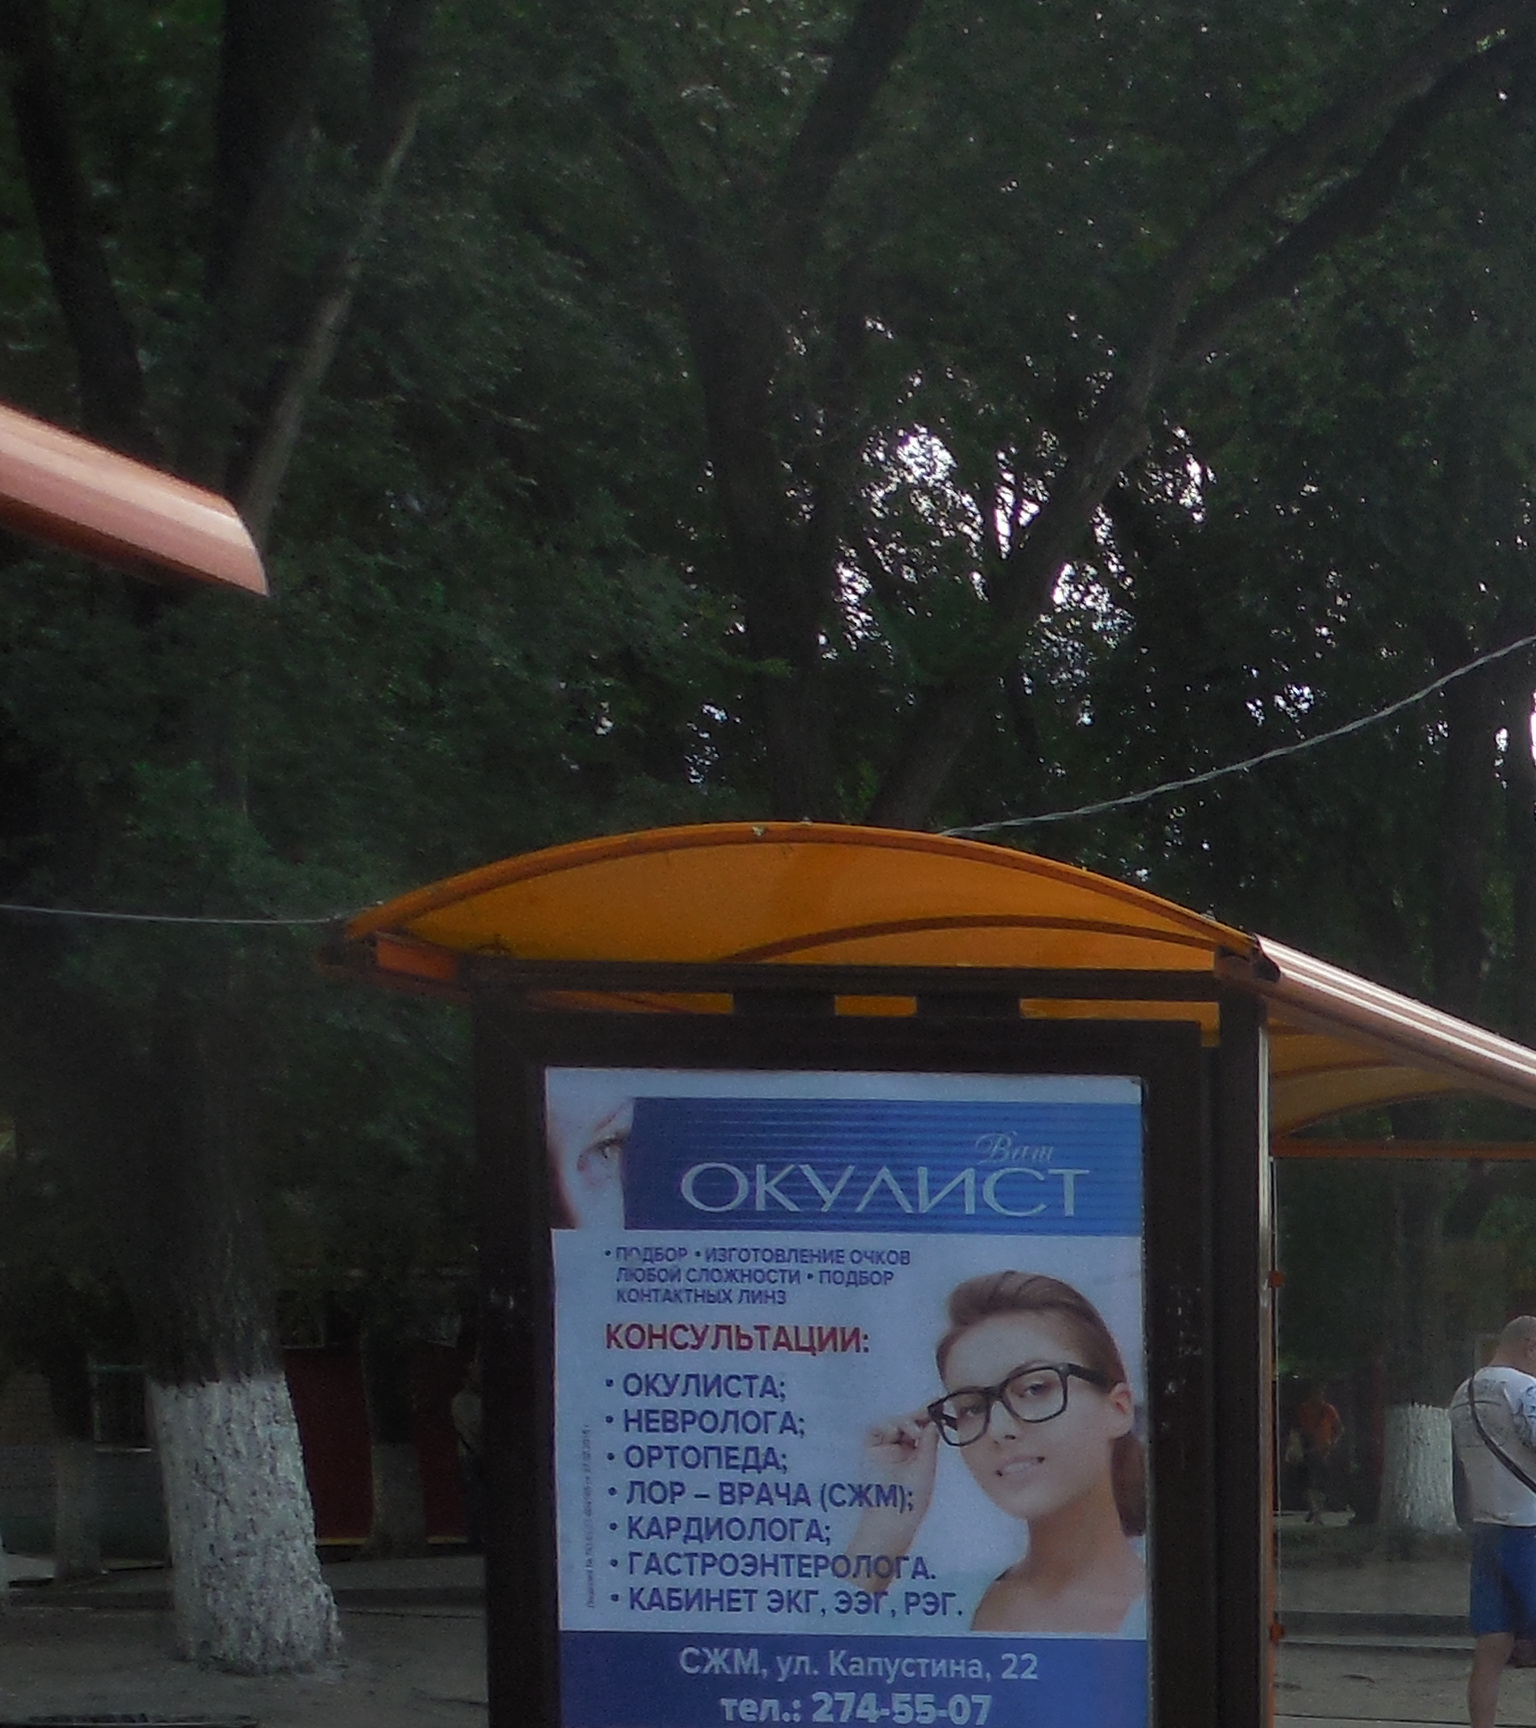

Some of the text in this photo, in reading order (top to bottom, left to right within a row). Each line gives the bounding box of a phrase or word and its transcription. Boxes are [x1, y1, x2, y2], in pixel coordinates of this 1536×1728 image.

[680, 1161, 1090, 1218] ОКУЛИСТ
[615, 1246, 911, 1266] ПОДБОР ИЗГОТОВЛЕНИЕ ОЧКОВ
[615, 1265, 894, 1287] ЛЮБОЙ СЛОЖНОСТИ ПОДБОР
[616, 1288, 787, 1305] КОНТАКТНЫХ ЛИНЗ
[605, 1322, 871, 1356] КОНСУЛЬТАЦИИ:
[622, 1373, 787, 1401] ОКУЛИСТА;
[623, 1409, 806, 1438] НЕВРОЛОГА;
[624, 1445, 789, 1475] ОРТОПЕДА;
[626, 1480, 687, 1506] ЛОР
[718, 1481, 812, 1507] ВРАЧА
[819, 1482, 914, 1513] (СЖМ);
[626, 1515, 832, 1547] КАРДИОЛОГА;
[628, 1552, 937, 1580] ГАСТРОЭНТЕРОЛОГА.
[628, 1586, 759, 1613] КАБИНЕТ
[904, 1591, 964, 1617] РЭГ.
[679, 1647, 1039, 1686] СЖМ, ул. Капустина, 22
[720, 1691, 992, 1727] тел.: 274-55-07
